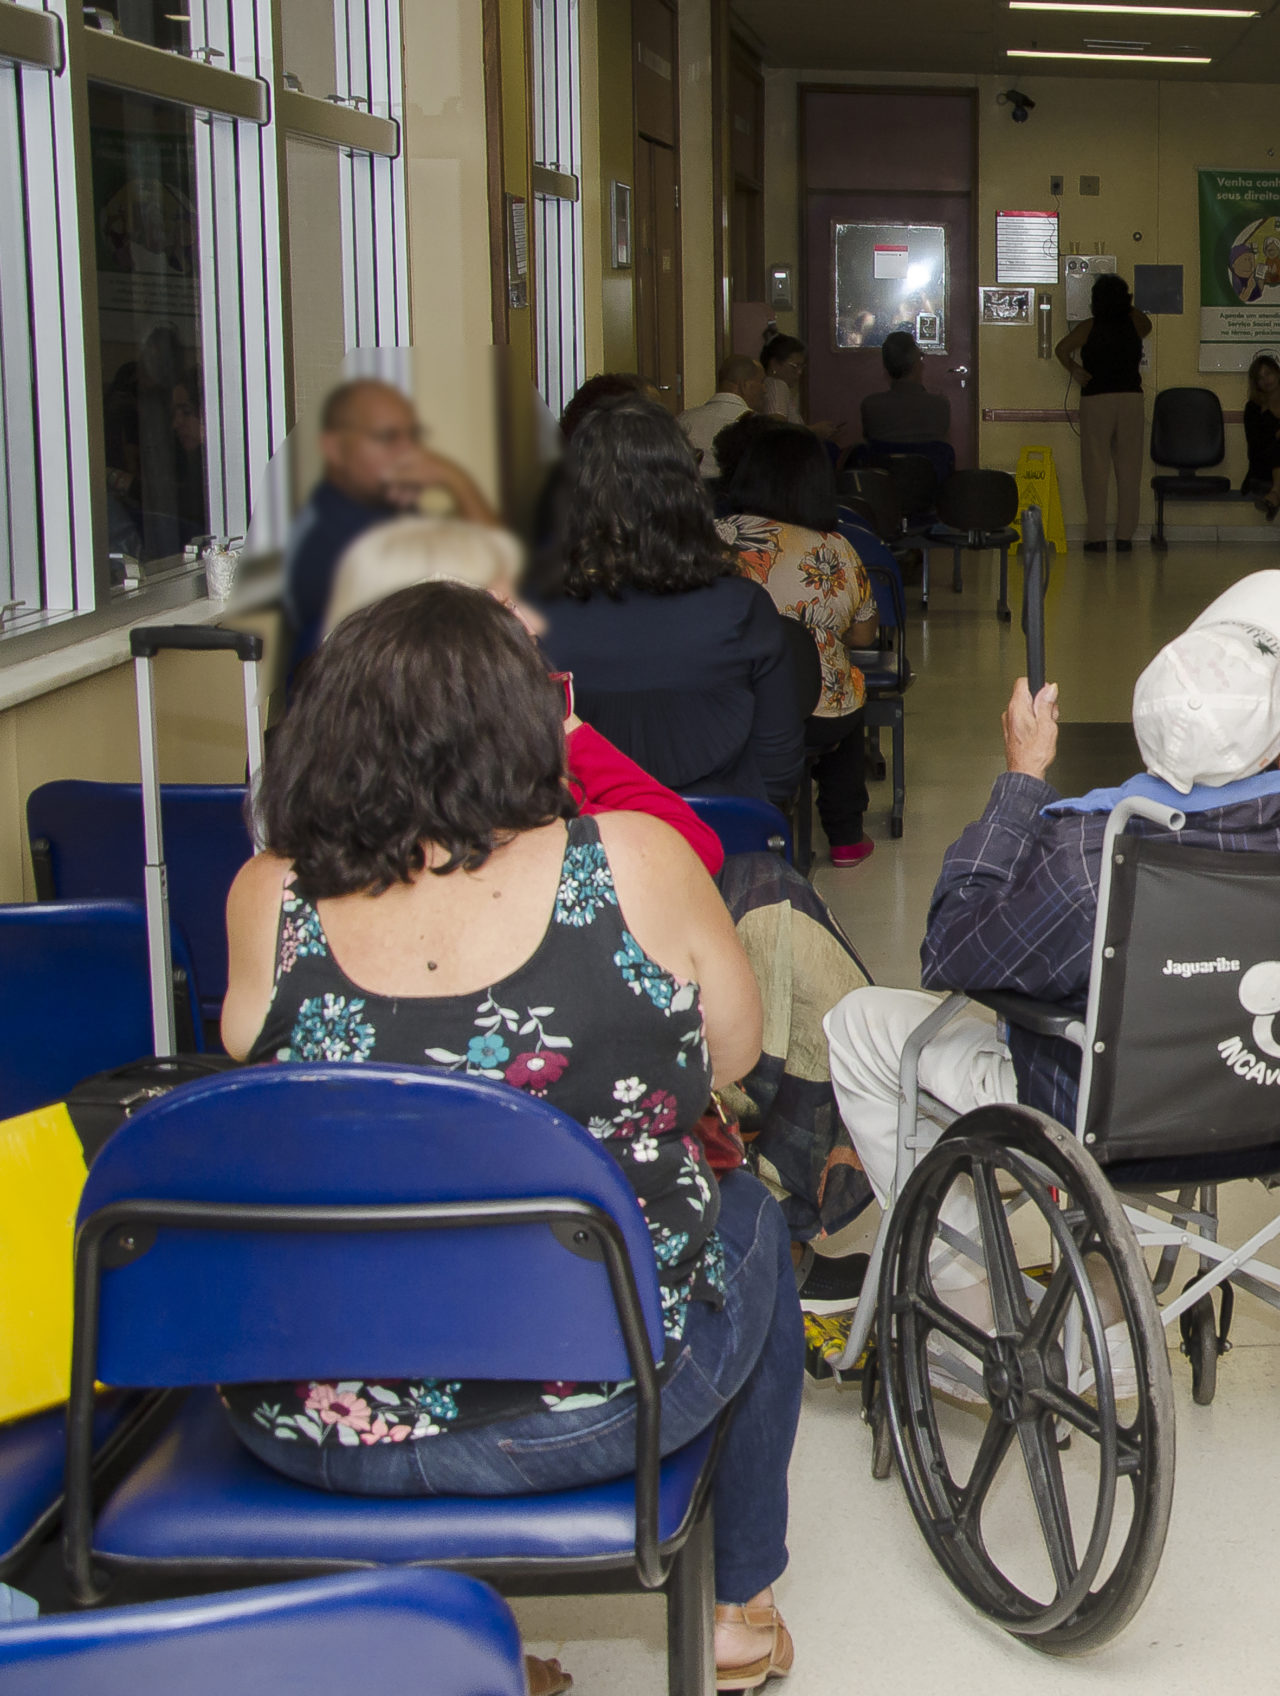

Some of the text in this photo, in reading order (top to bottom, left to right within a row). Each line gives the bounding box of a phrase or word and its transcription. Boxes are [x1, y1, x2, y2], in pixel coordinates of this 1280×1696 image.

[1216, 177, 1252, 187] Venha
[1216, 192, 1241, 200] seus
[1163, 957, 1241, 978] Jaguaribe
